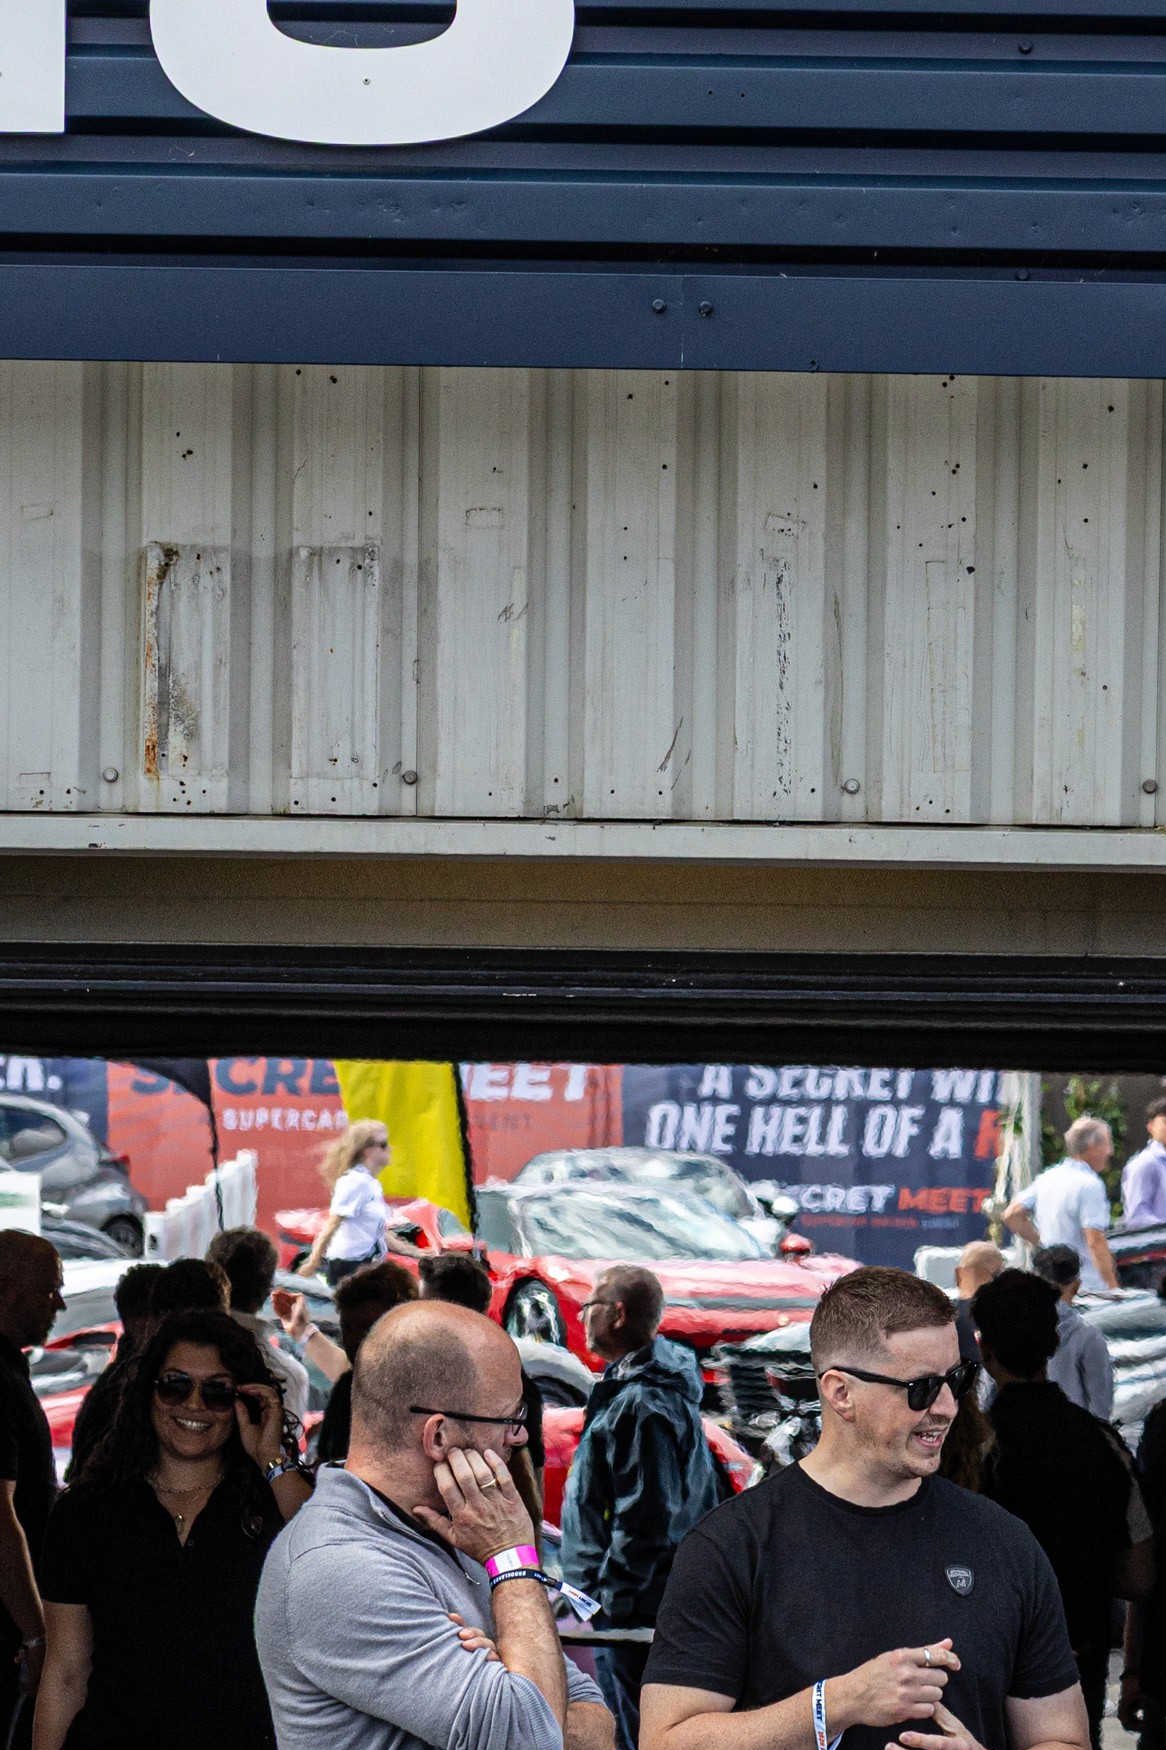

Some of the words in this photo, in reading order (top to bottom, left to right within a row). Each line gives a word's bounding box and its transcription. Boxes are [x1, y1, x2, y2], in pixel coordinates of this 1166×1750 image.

[131, 1058, 341, 1095] CRE
[459, 1063, 600, 1101] EET
[699, 1065, 733, 1100] A
[645, 1102, 741, 1154] ONE
[745, 1105, 850, 1157] HELL
[862, 1106, 926, 1158] OF
[929, 1107, 964, 1159] A
[785, 1184, 895, 1214] CRET
[897, 1187, 991, 1214] MEET
